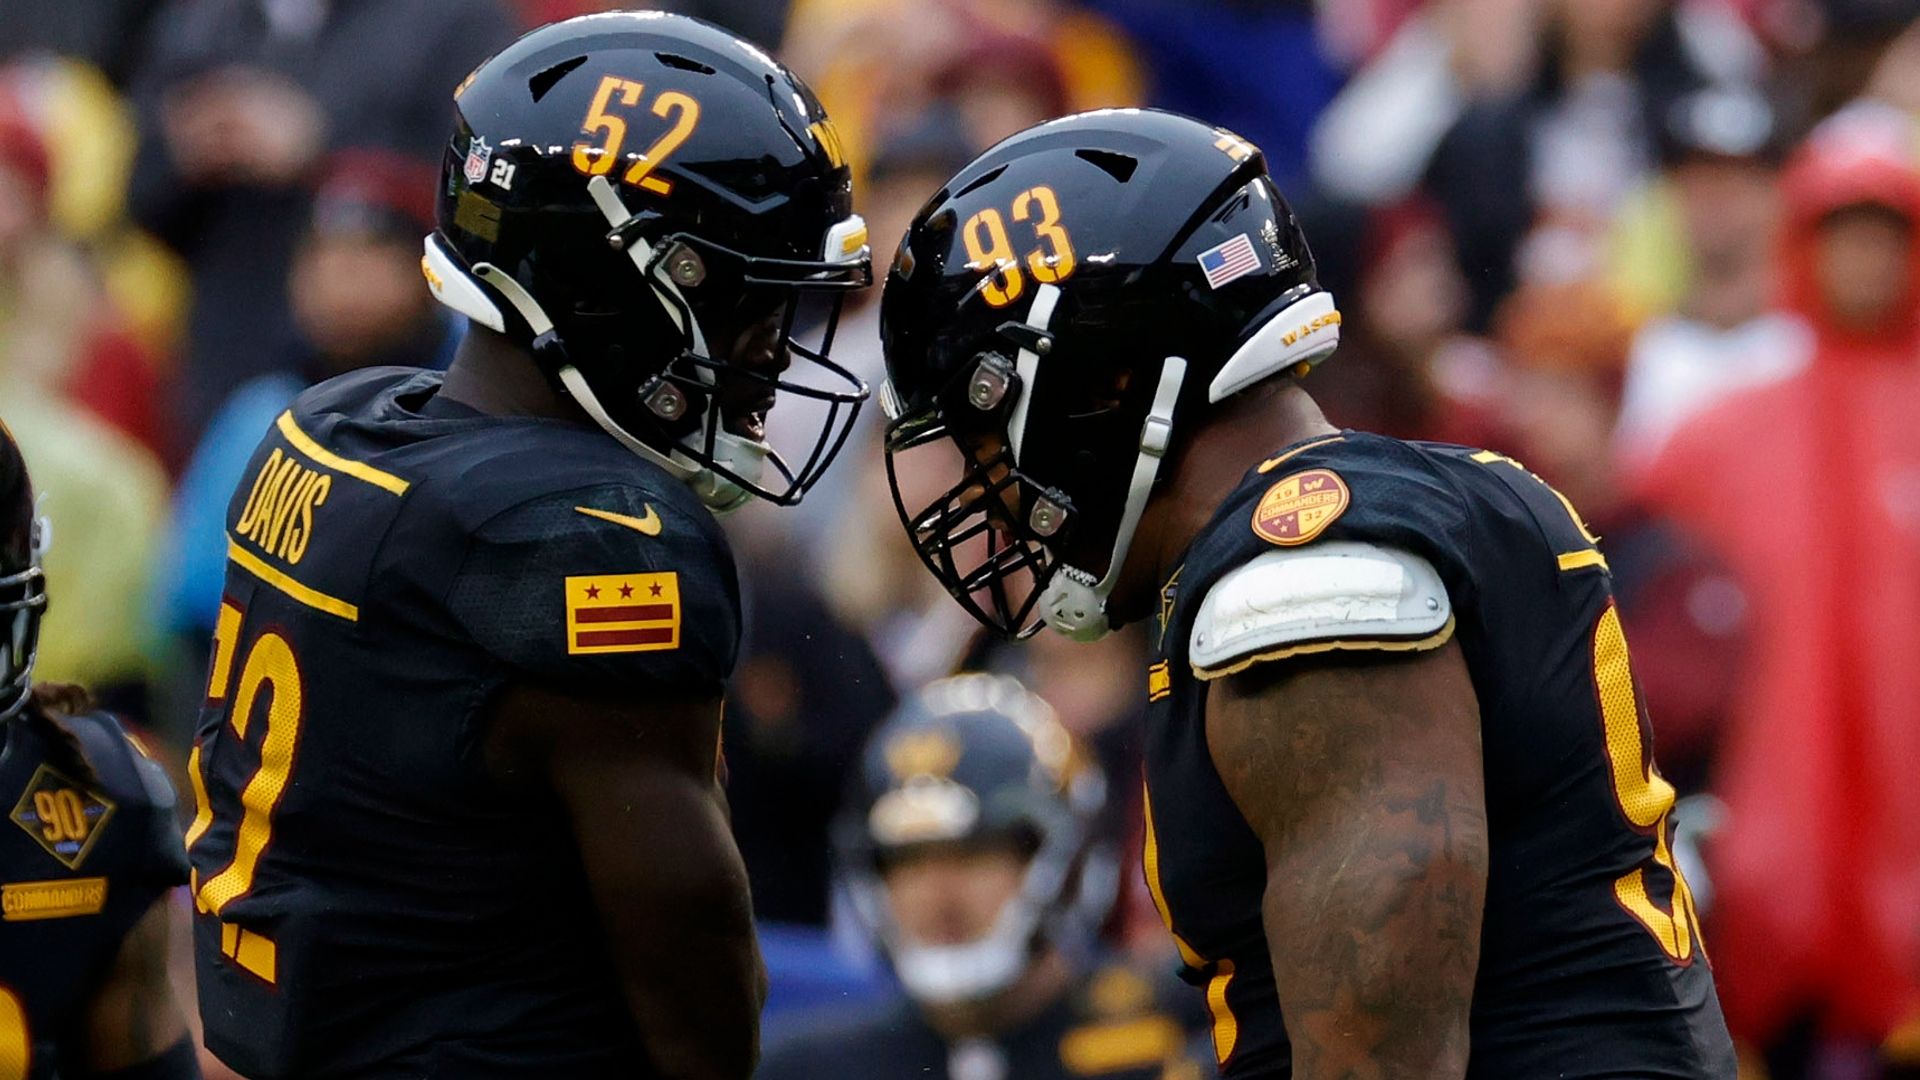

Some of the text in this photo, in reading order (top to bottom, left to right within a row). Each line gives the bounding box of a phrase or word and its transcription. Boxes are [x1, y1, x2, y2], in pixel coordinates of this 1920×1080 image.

[490, 158, 516, 190] 21
[570, 74, 701, 197] 52
[962, 184, 1077, 309] 93
[235, 447, 332, 565] DAVIS
[1261, 492, 1339, 519] COMMANDERS
[33, 787, 89, 842] 90
